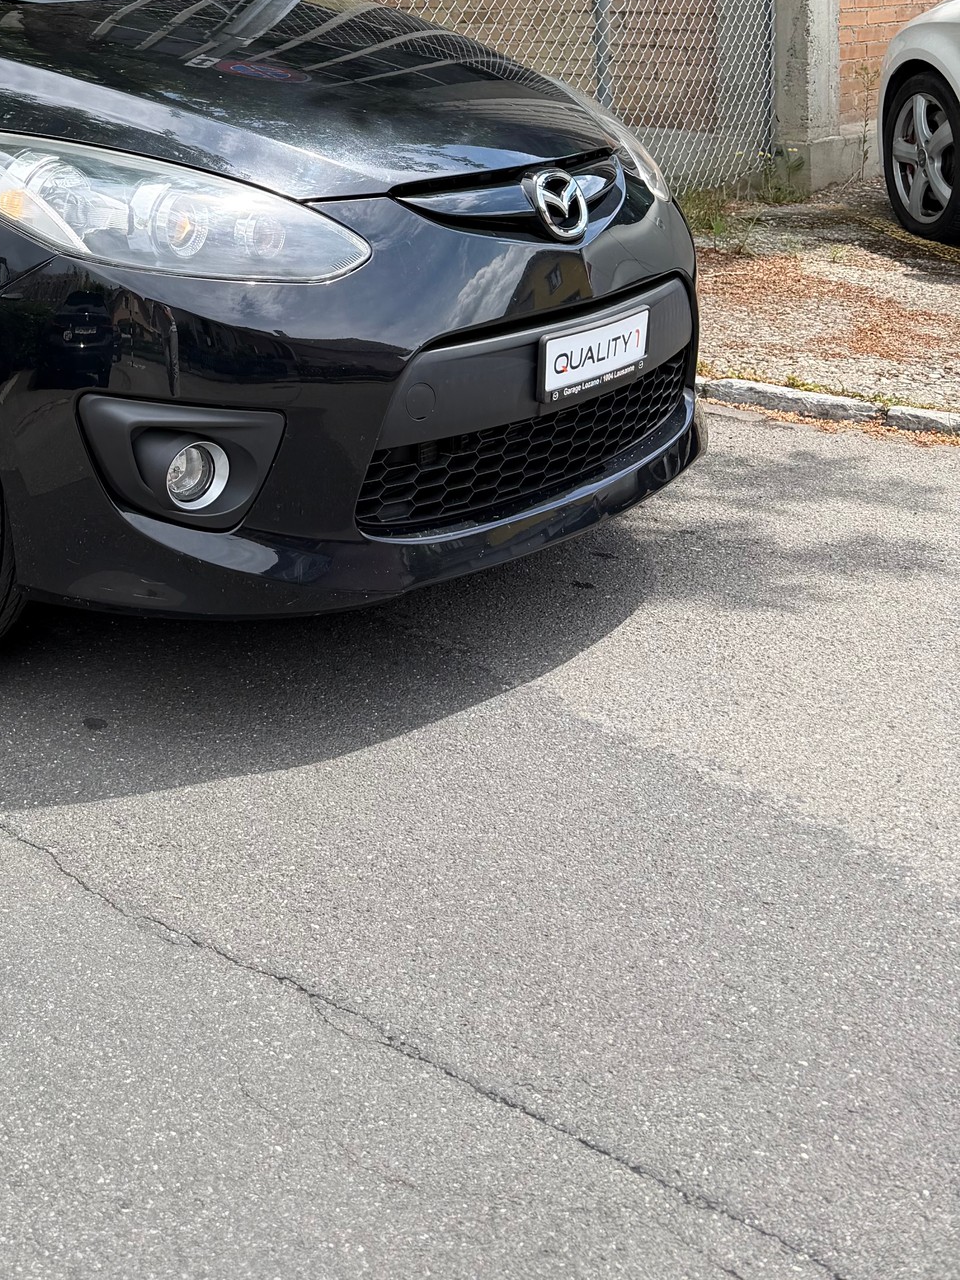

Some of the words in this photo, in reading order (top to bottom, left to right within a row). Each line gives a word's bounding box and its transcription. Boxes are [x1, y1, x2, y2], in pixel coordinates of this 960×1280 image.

[553, 331, 633, 375] QUALITY
[563, 383, 581, 396] Garage
[614, 364, 635, 379] Lausanne
